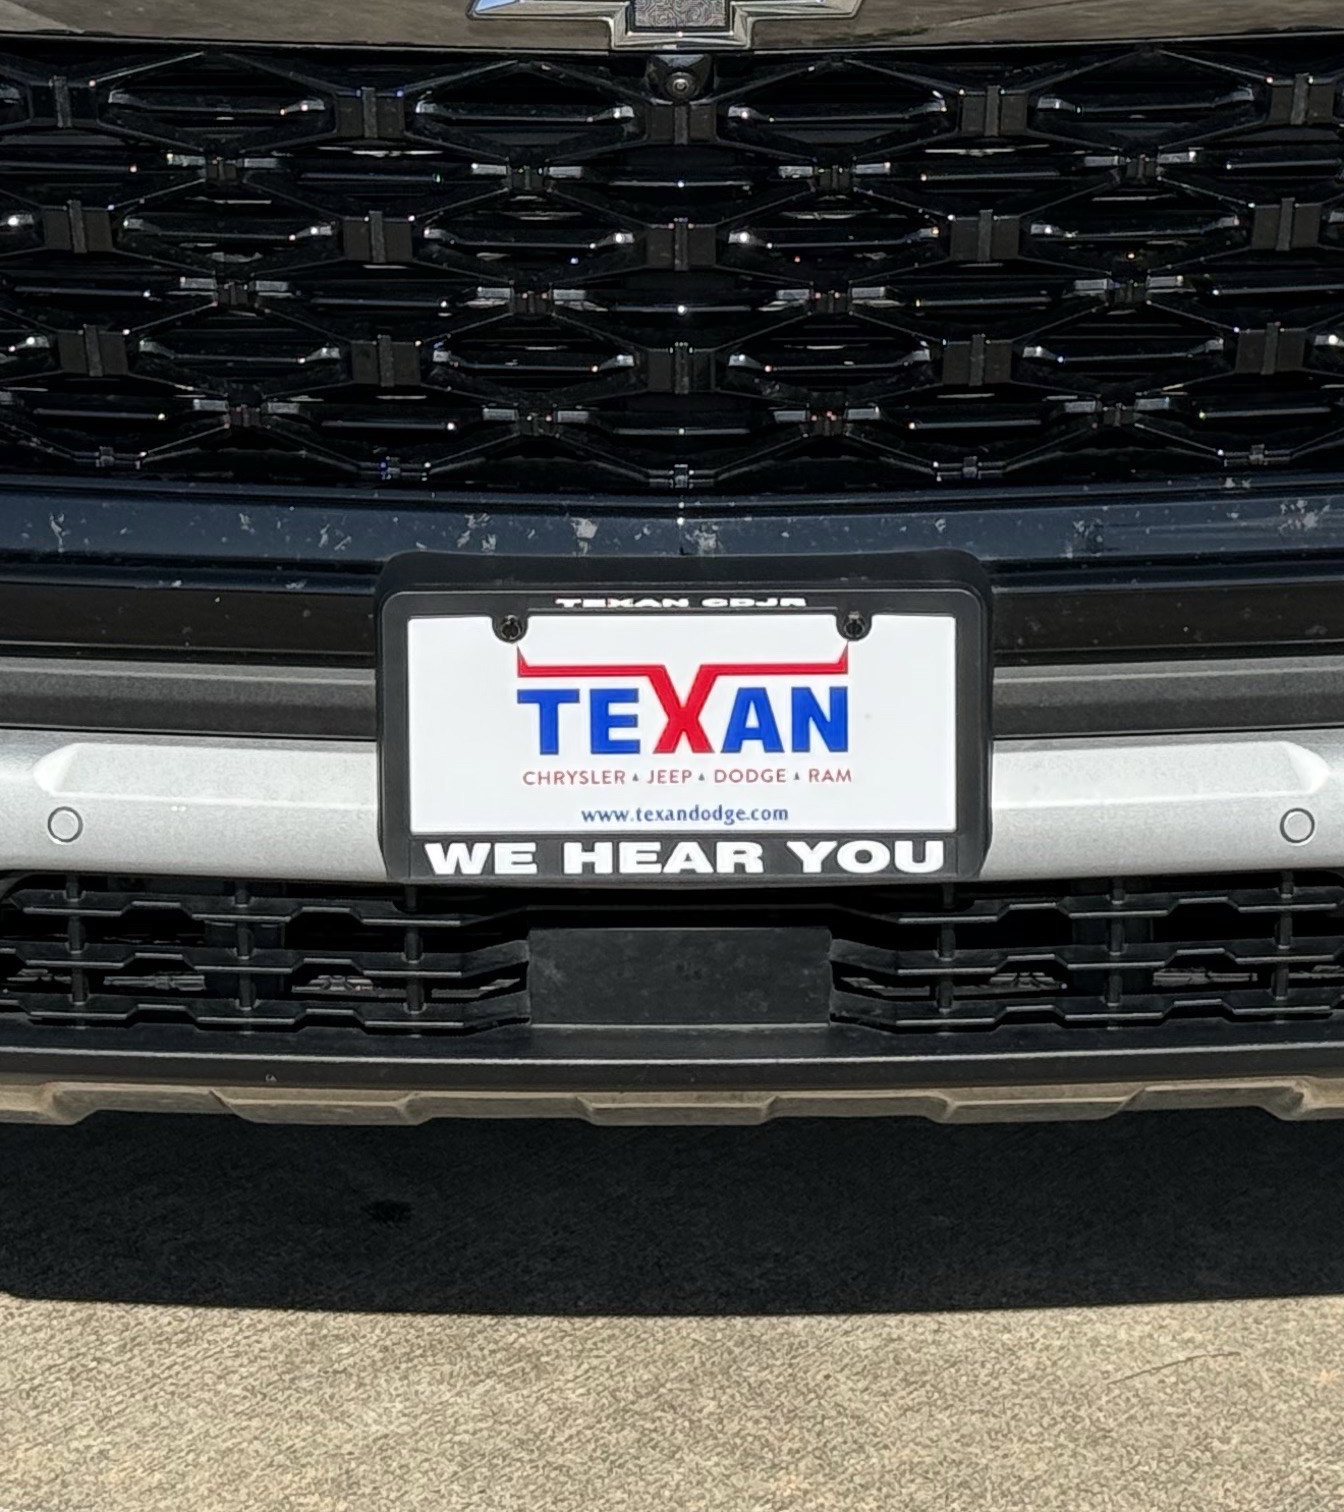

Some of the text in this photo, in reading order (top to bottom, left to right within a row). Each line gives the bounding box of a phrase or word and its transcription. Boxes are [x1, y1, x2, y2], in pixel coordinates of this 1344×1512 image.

[517, 664, 849, 755] TEXAN
[522, 767, 853, 787] CHRYSLER JEEP DODGE RAM
[581, 804, 789, 825] www.texandodge.com
[424, 840, 946, 876] WE HEAR YOU
